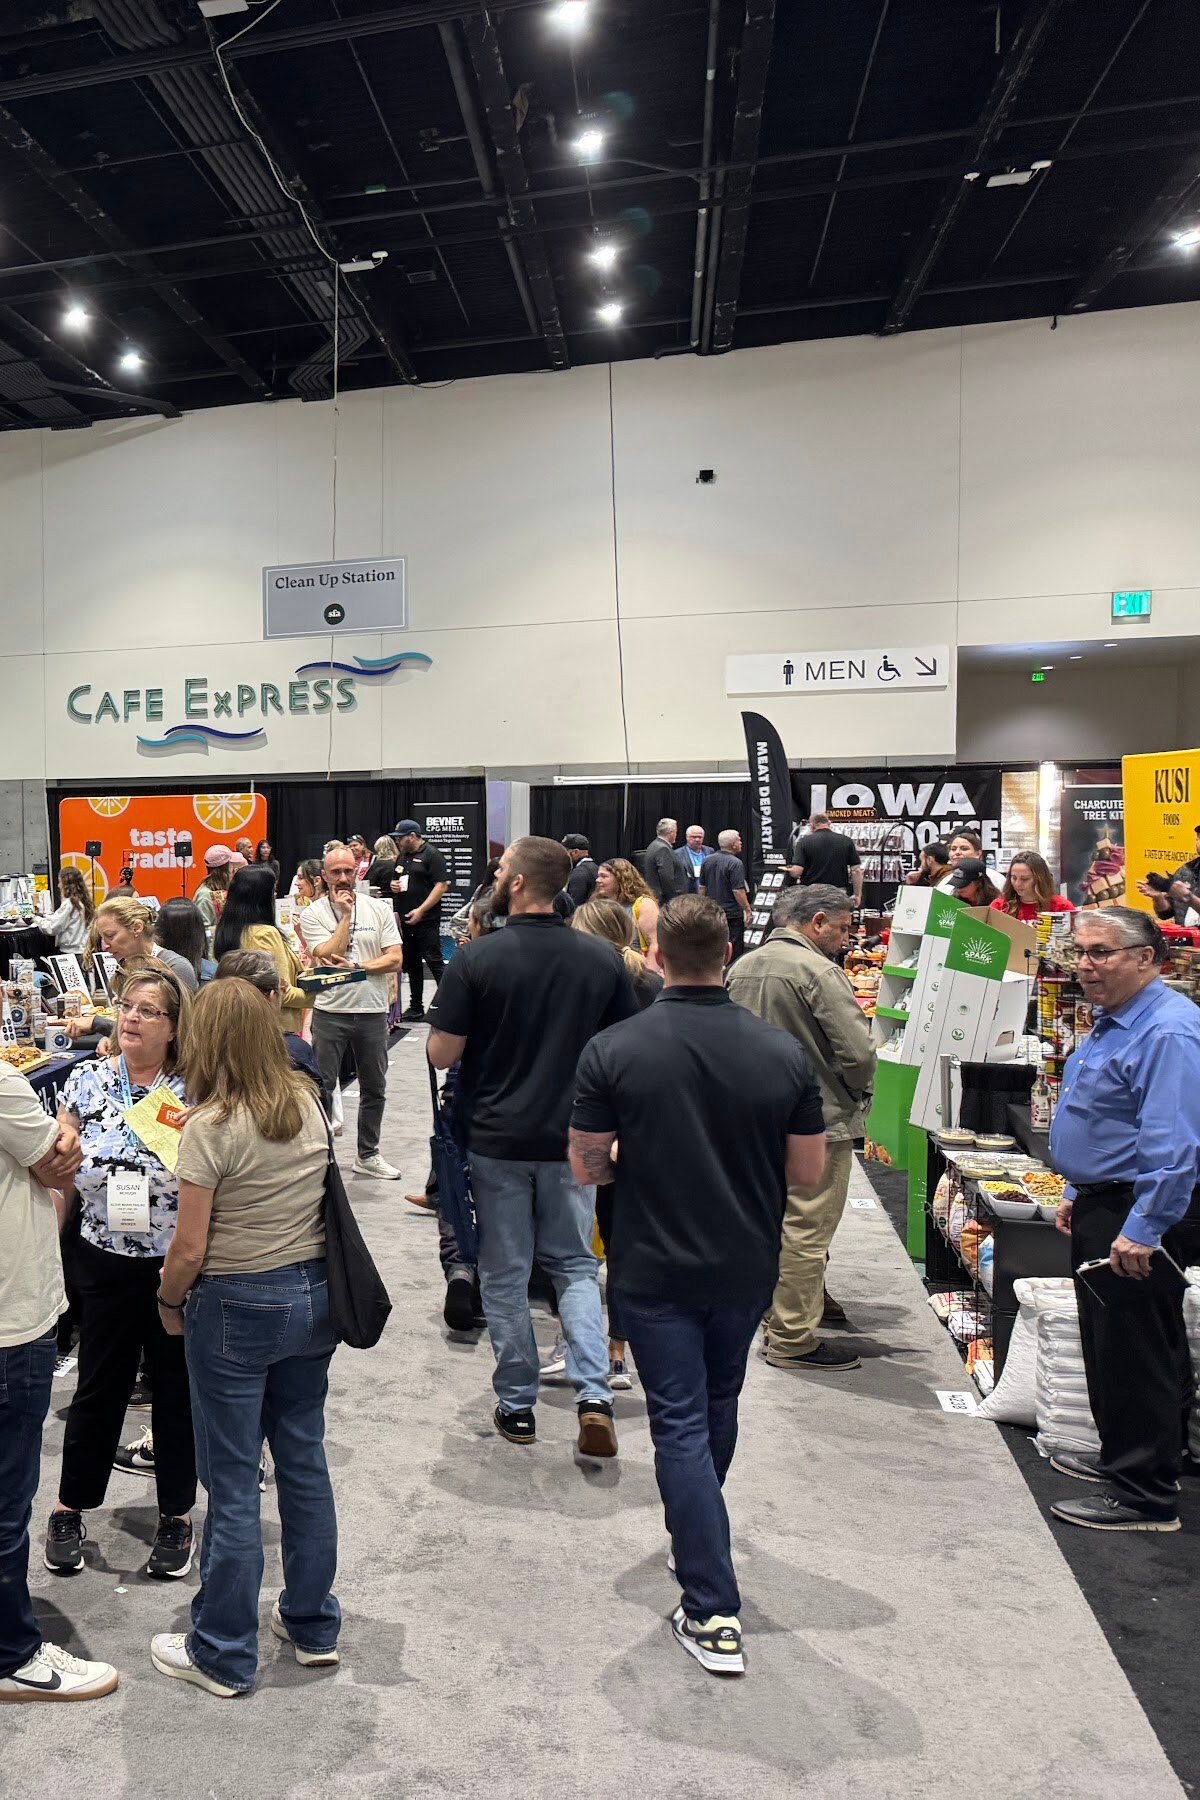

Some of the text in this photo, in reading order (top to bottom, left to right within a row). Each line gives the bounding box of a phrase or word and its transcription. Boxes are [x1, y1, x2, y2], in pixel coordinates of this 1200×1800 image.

[275, 569, 396, 590] Clean Up Station
[327, 609, 341, 618] sfa
[805, 660, 866, 681] MEN
[67, 684, 164, 721] CAFE
[756, 741, 770, 783] MEAT
[1154, 767, 1190, 804] KUSI
[811, 782, 977, 816] IOWA
[425, 816, 465, 826] BEVNET
[826, 808, 876, 818] SMOKED MEATS
[1083, 810, 1107, 821] TREE
[1162, 813, 1180, 826] FOODS
[129, 827, 192, 847] taste
